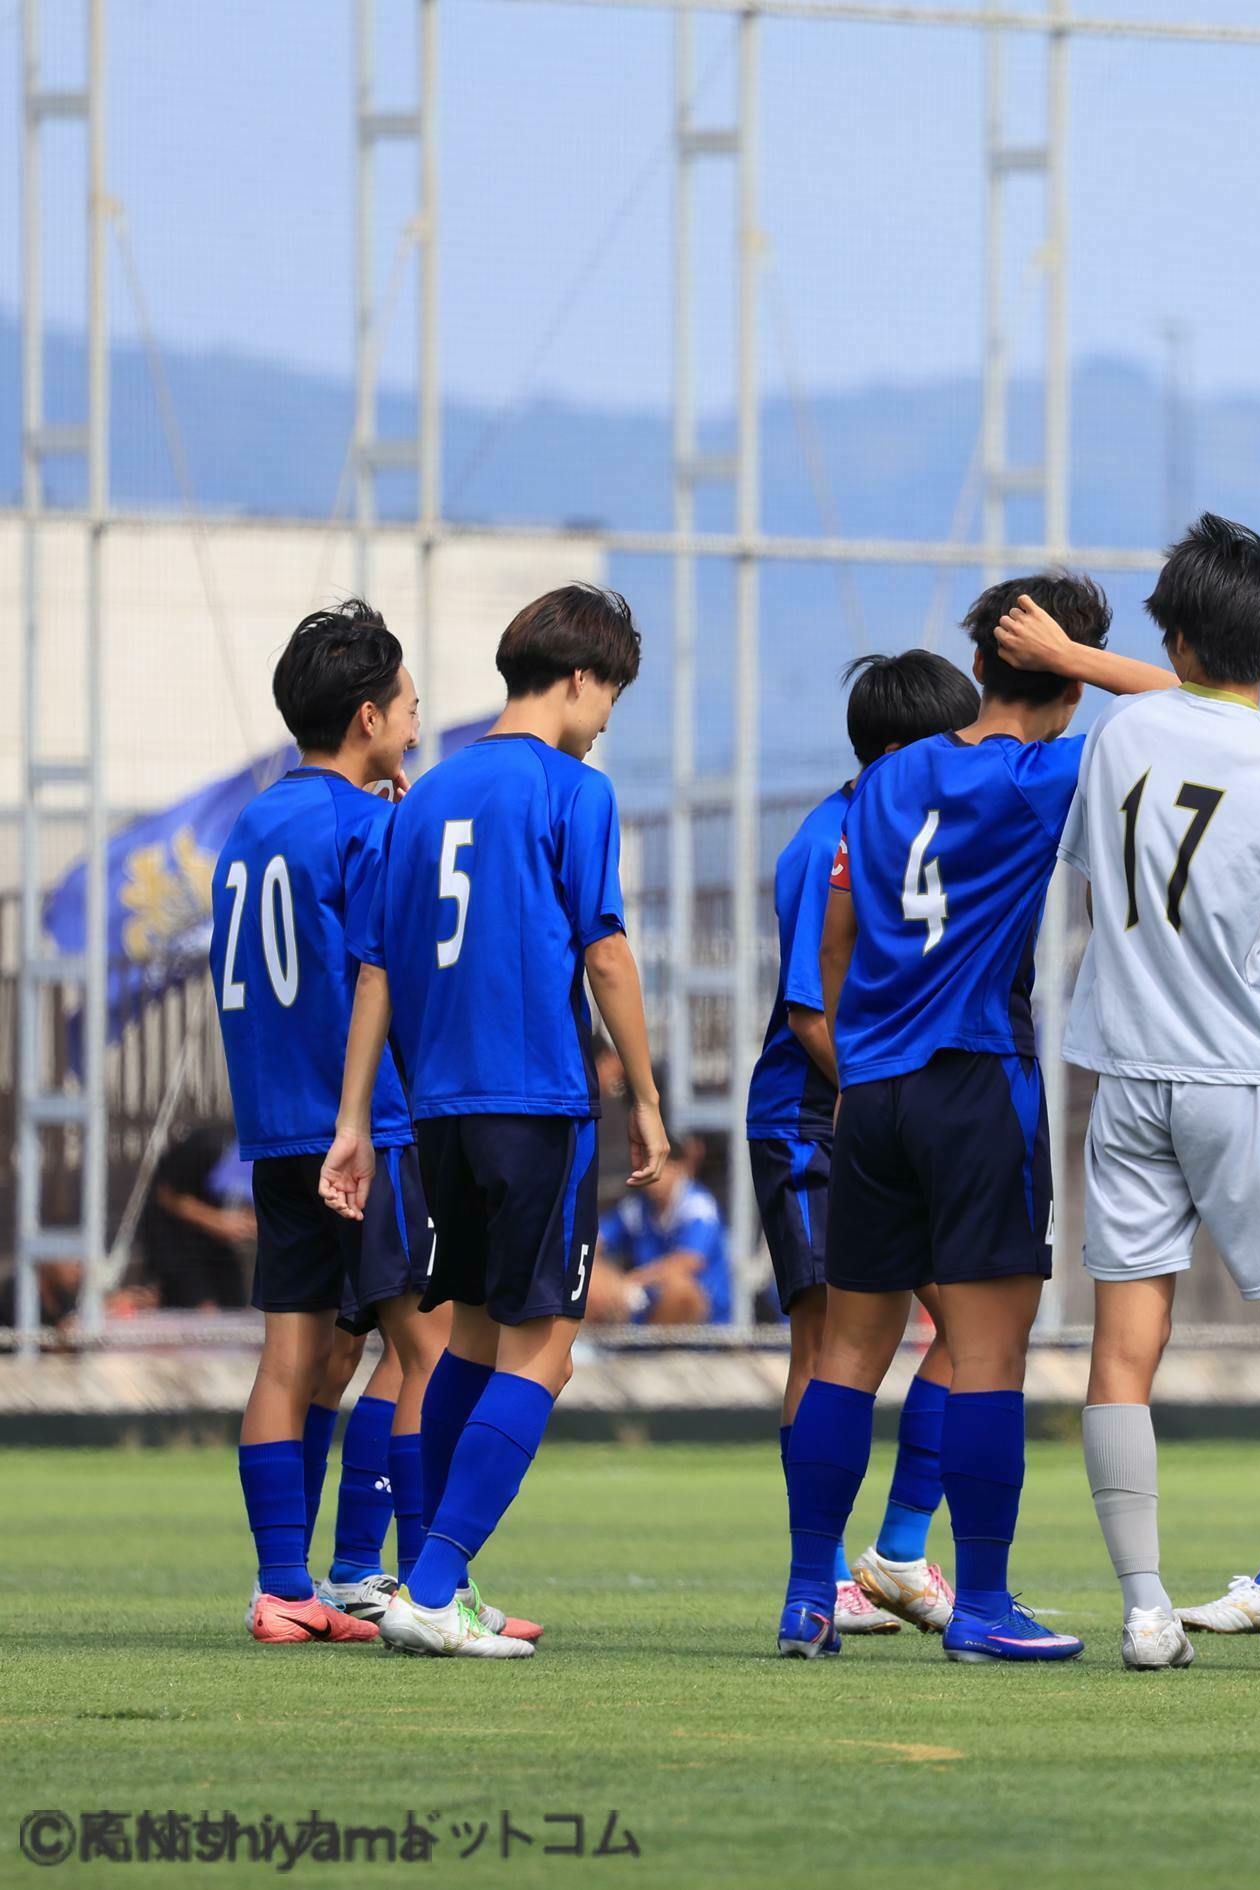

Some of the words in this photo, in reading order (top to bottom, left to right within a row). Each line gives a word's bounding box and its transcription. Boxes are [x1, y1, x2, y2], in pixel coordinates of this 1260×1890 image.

[436, 817, 474, 969] 5
[901, 808, 948, 956] 4
[1119, 766, 1227, 933] 17
[222, 854, 299, 1011] 20
[570, 1243, 590, 1301] 5
